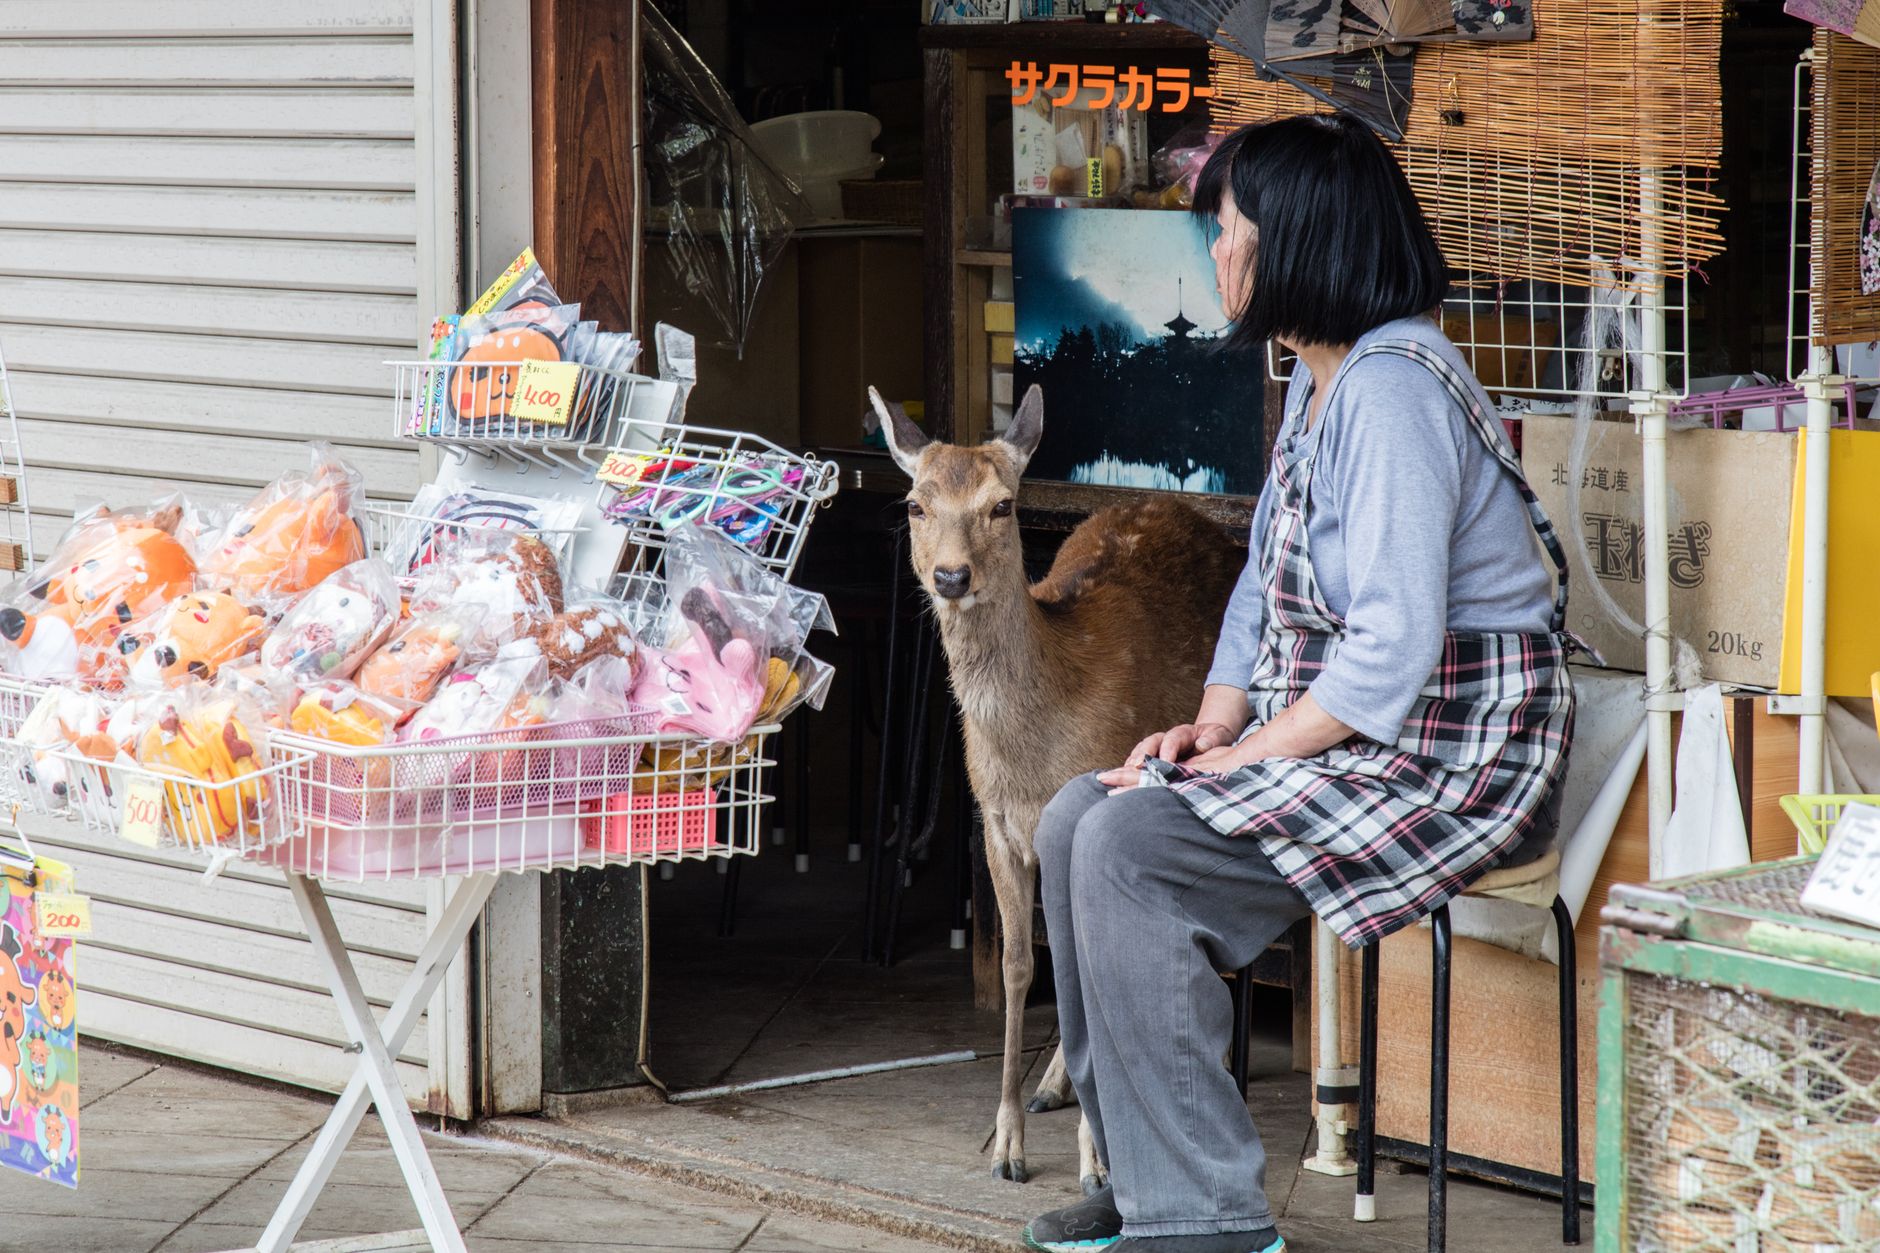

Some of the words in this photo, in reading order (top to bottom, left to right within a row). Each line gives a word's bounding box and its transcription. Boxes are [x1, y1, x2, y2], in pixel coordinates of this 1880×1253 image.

[1005, 61, 1222, 112] サクラカラー
[524, 384, 561, 407] 400
[599, 458, 638, 477] 300
[1708, 630, 1764, 661] 20kg
[127, 794, 158, 825] 500
[46, 912, 81, 929] 200
